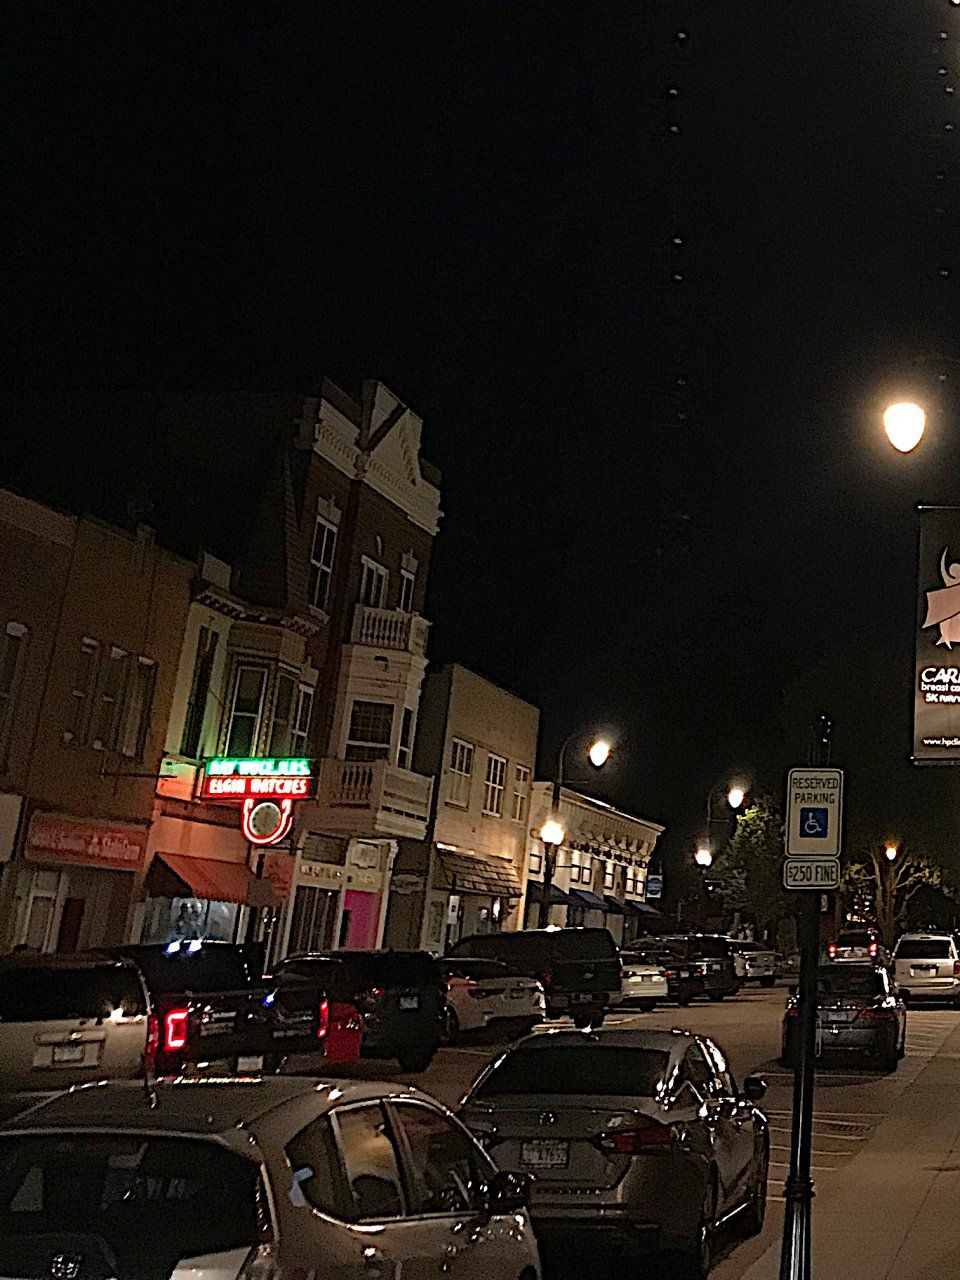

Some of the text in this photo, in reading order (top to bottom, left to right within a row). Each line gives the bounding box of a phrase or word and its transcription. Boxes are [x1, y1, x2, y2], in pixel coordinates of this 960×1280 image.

[921, 682, 949, 692] breast
[925, 692, 938, 703] 5K
[250, 778, 307, 794] WATCHES
[792, 777, 839, 790] RESERVED
[794, 792, 836, 804] PARKING
[788, 865, 836, 882] $250 FINE
